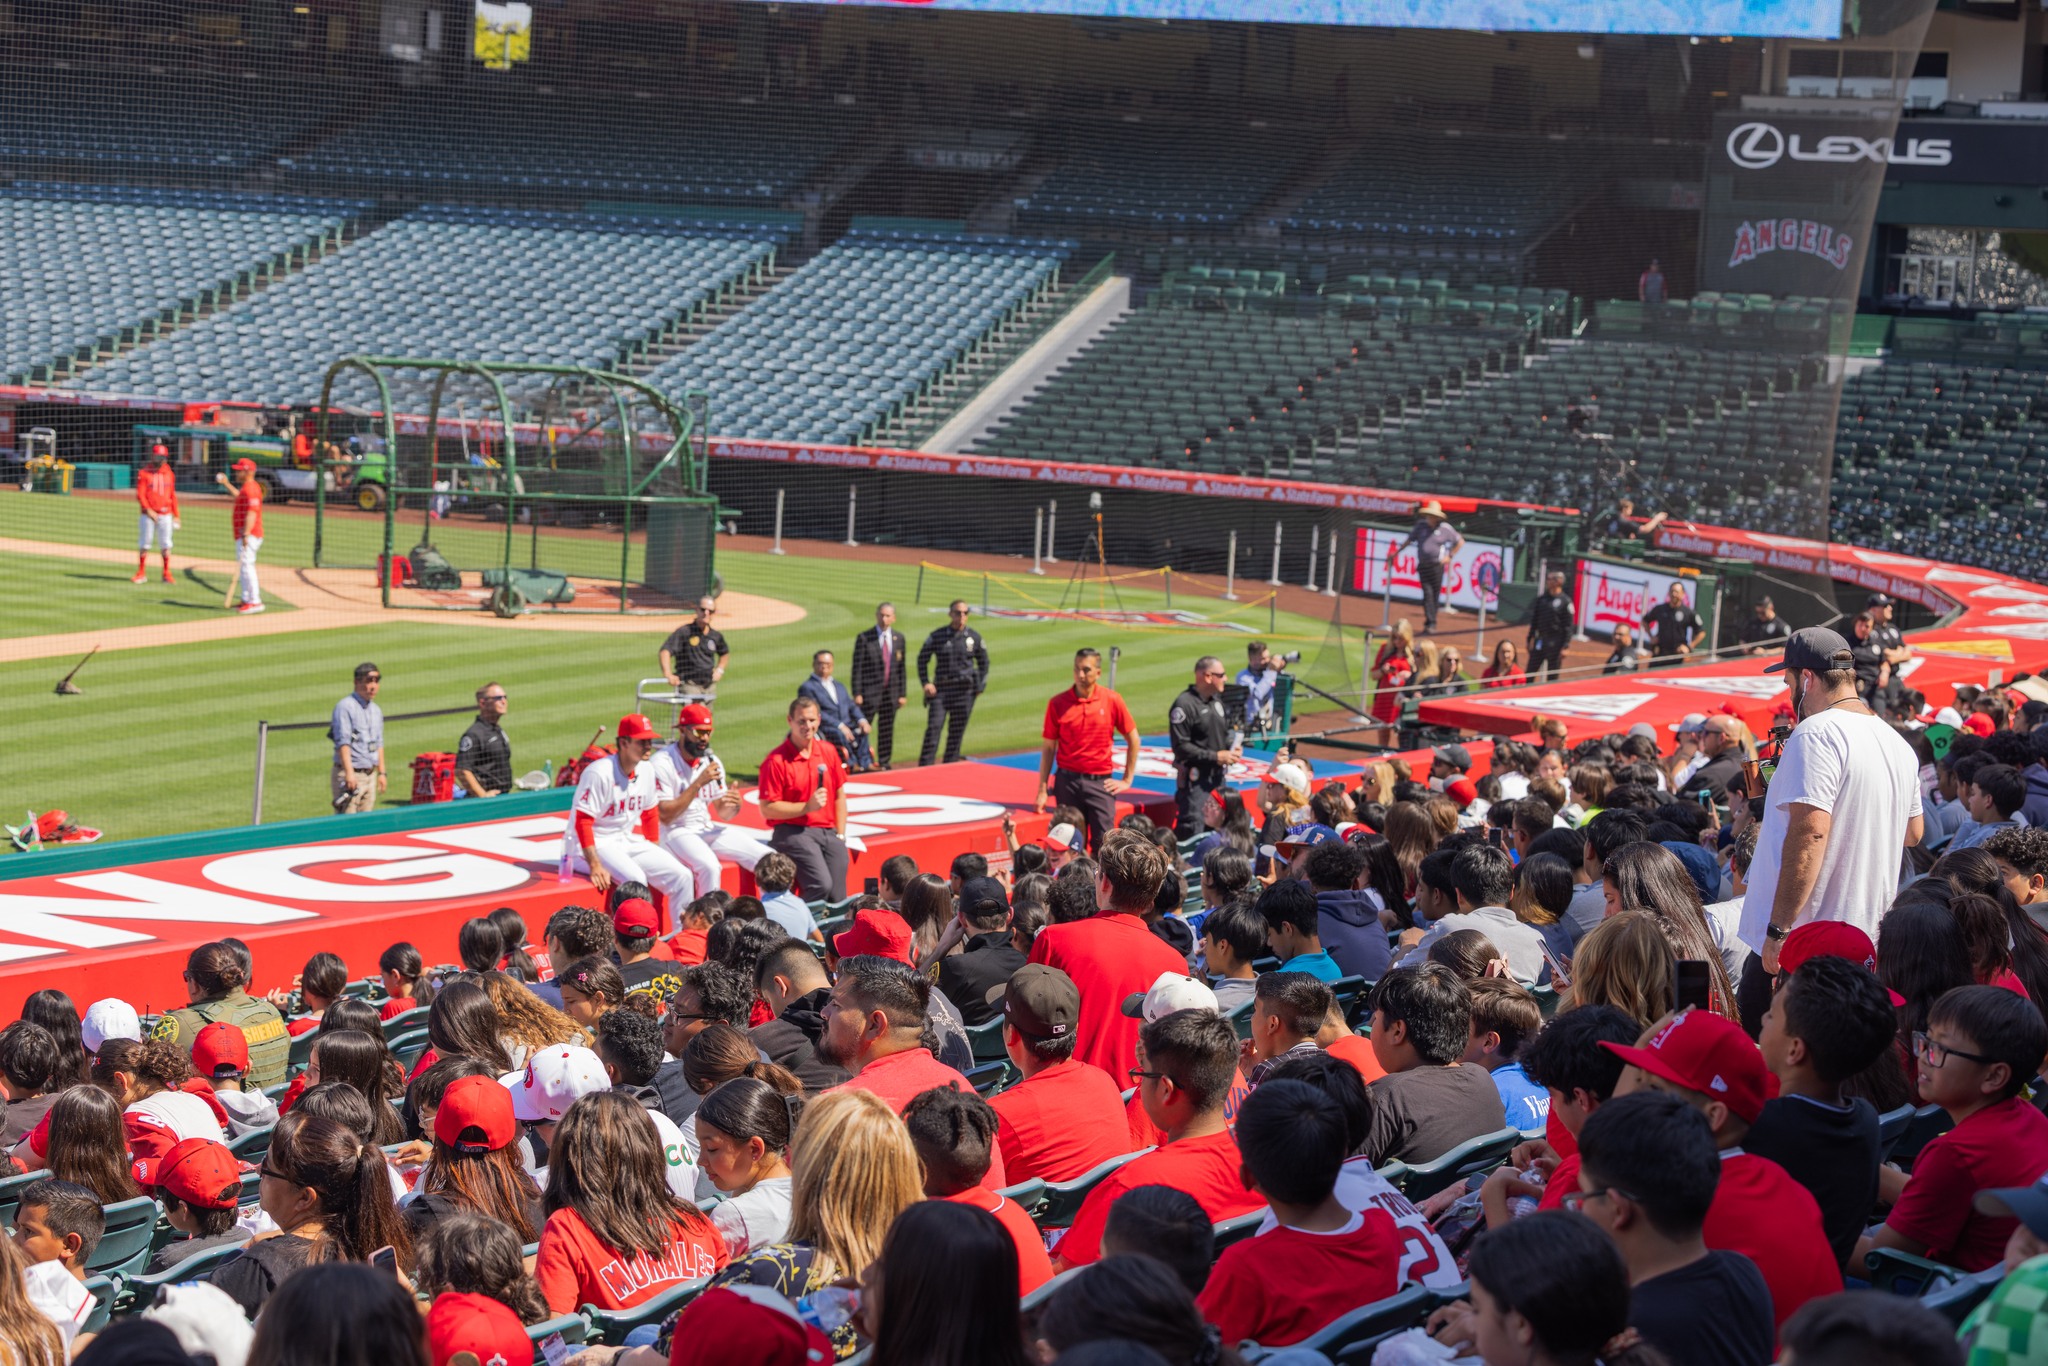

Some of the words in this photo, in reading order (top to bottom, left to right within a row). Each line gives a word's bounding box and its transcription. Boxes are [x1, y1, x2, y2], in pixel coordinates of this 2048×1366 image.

[1788, 134, 1953, 166] LEXUS
[1728, 218, 1853, 270] ANGELS
[245, 1018, 285, 1044] SHERIFF
